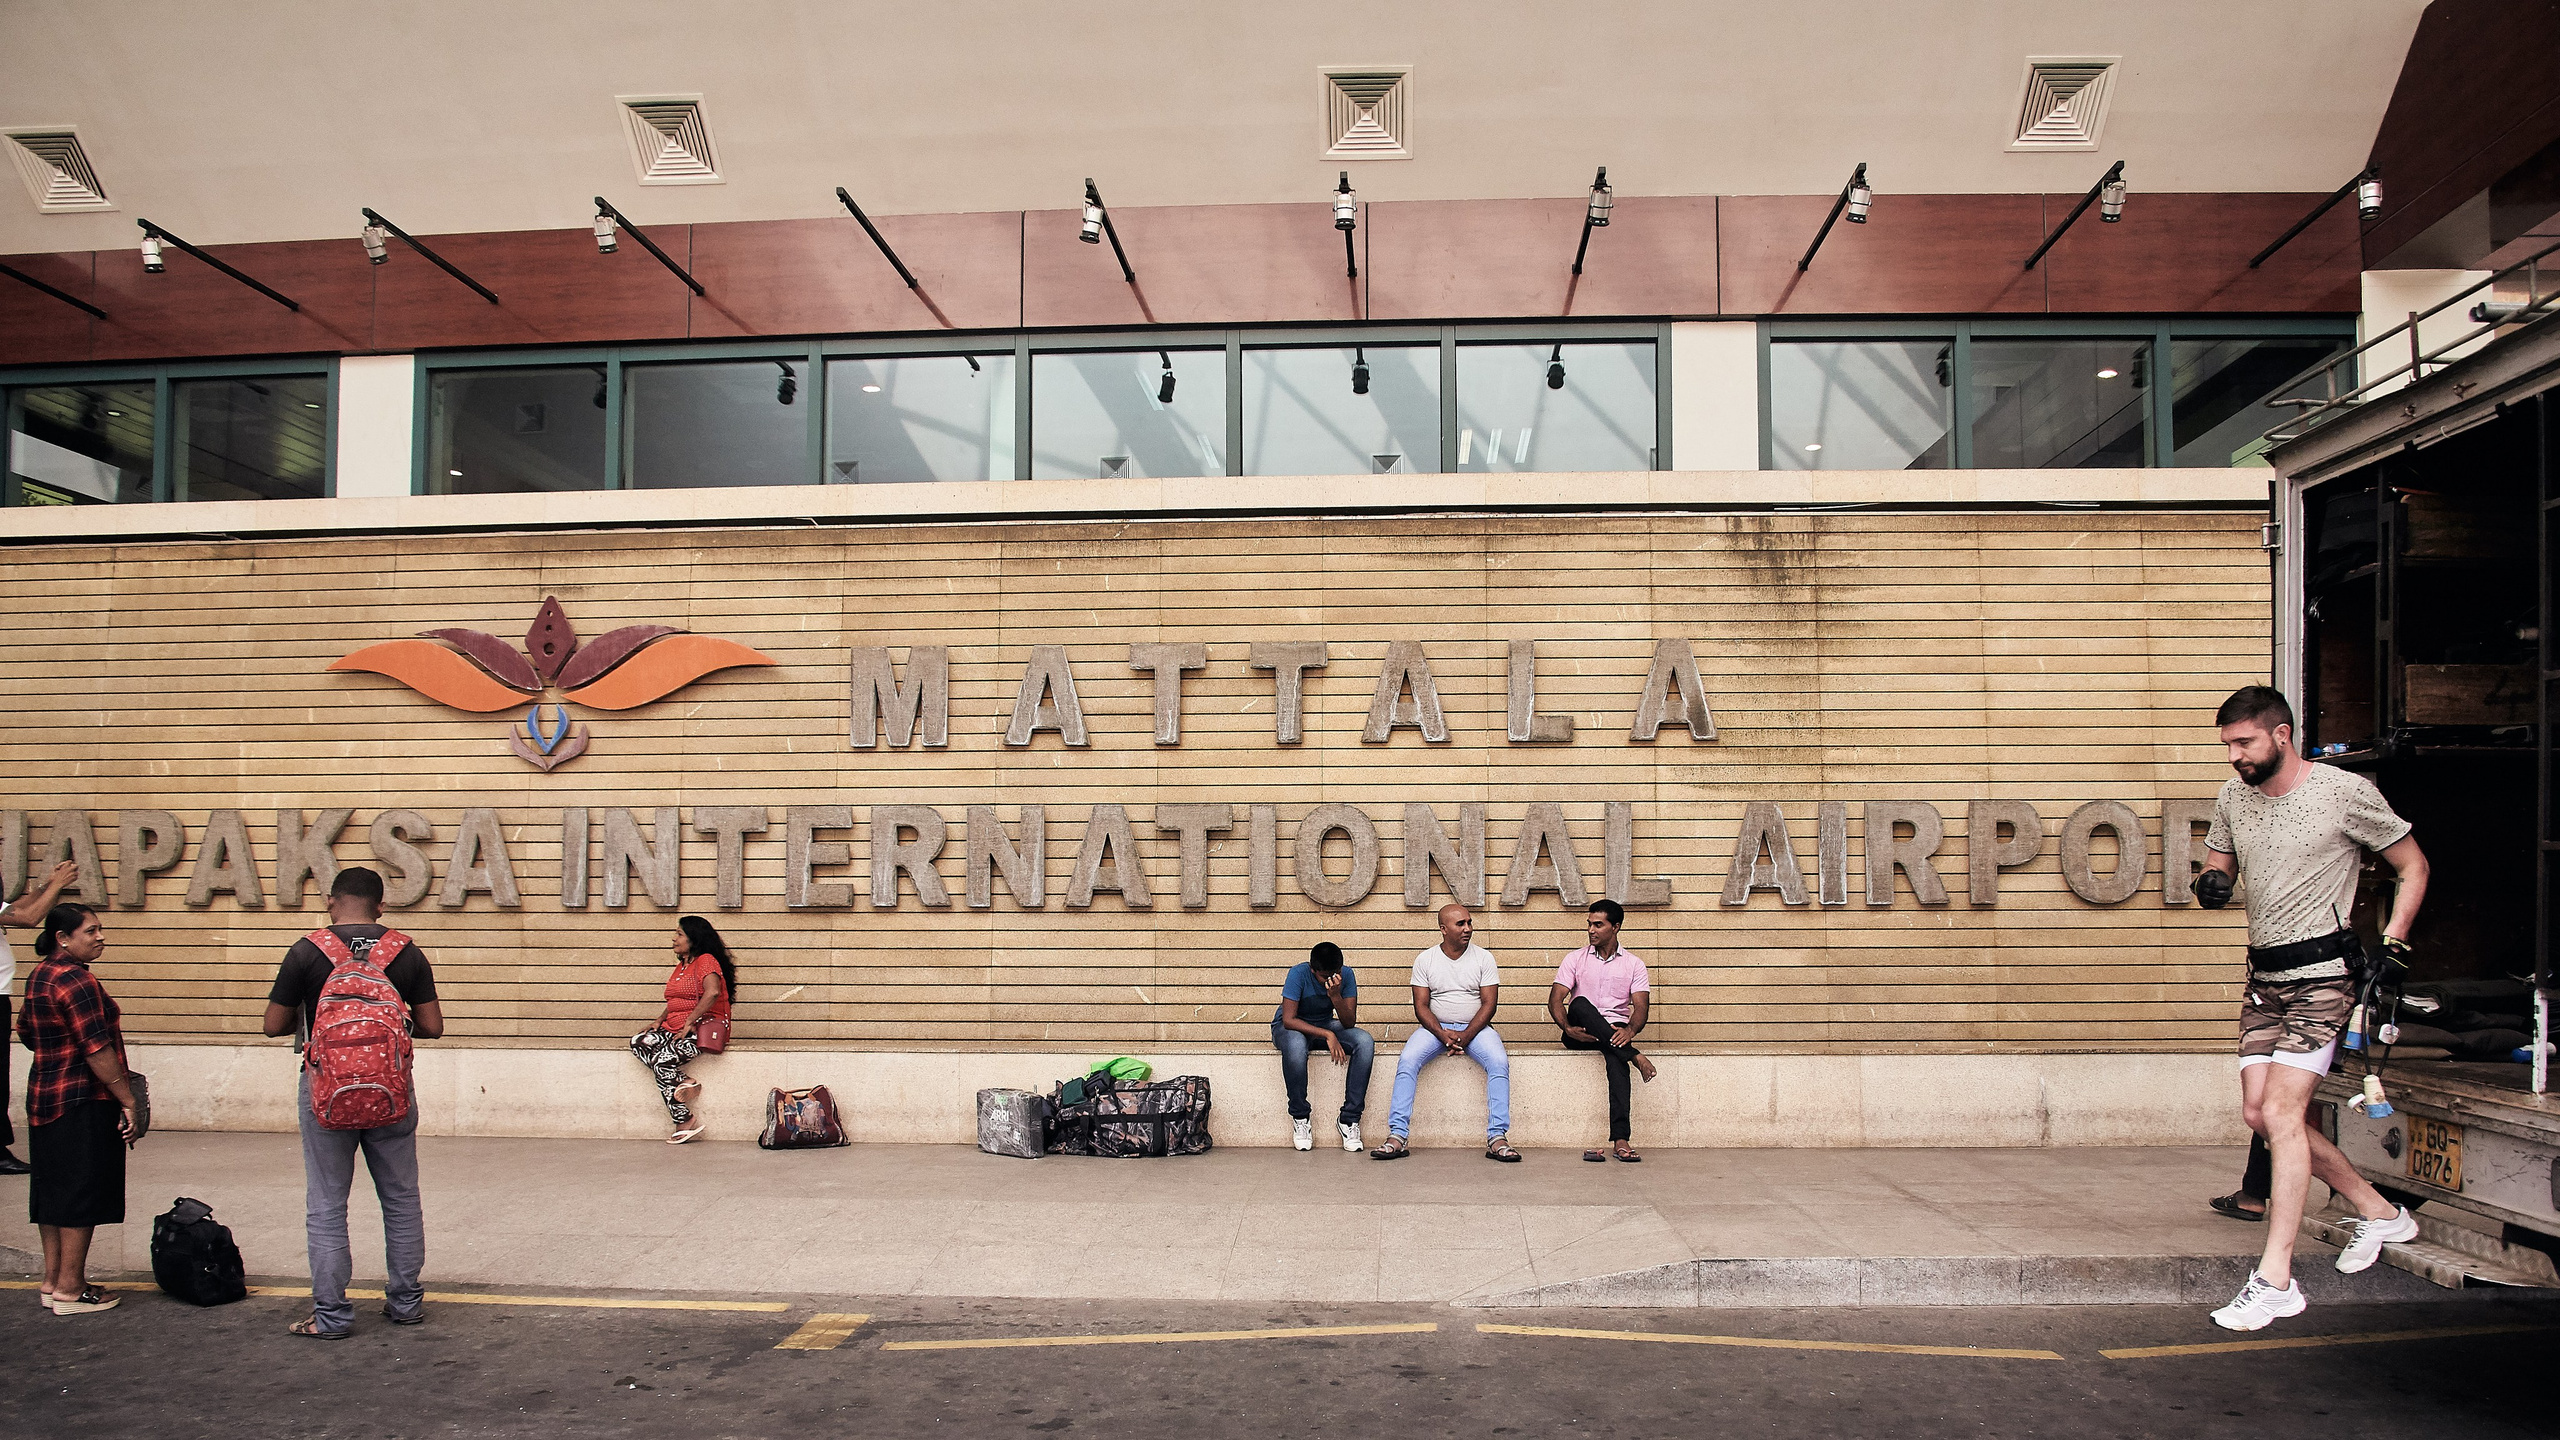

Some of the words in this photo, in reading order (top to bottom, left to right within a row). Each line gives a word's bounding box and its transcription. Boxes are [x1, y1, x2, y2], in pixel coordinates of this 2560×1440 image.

[850, 638, 1719, 748] MATTALA
[561, 802, 1673, 908] INTERNATIONAL
[990, 1109, 1010, 1122] ARRI
[2413, 1149, 2453, 1183] 0876
